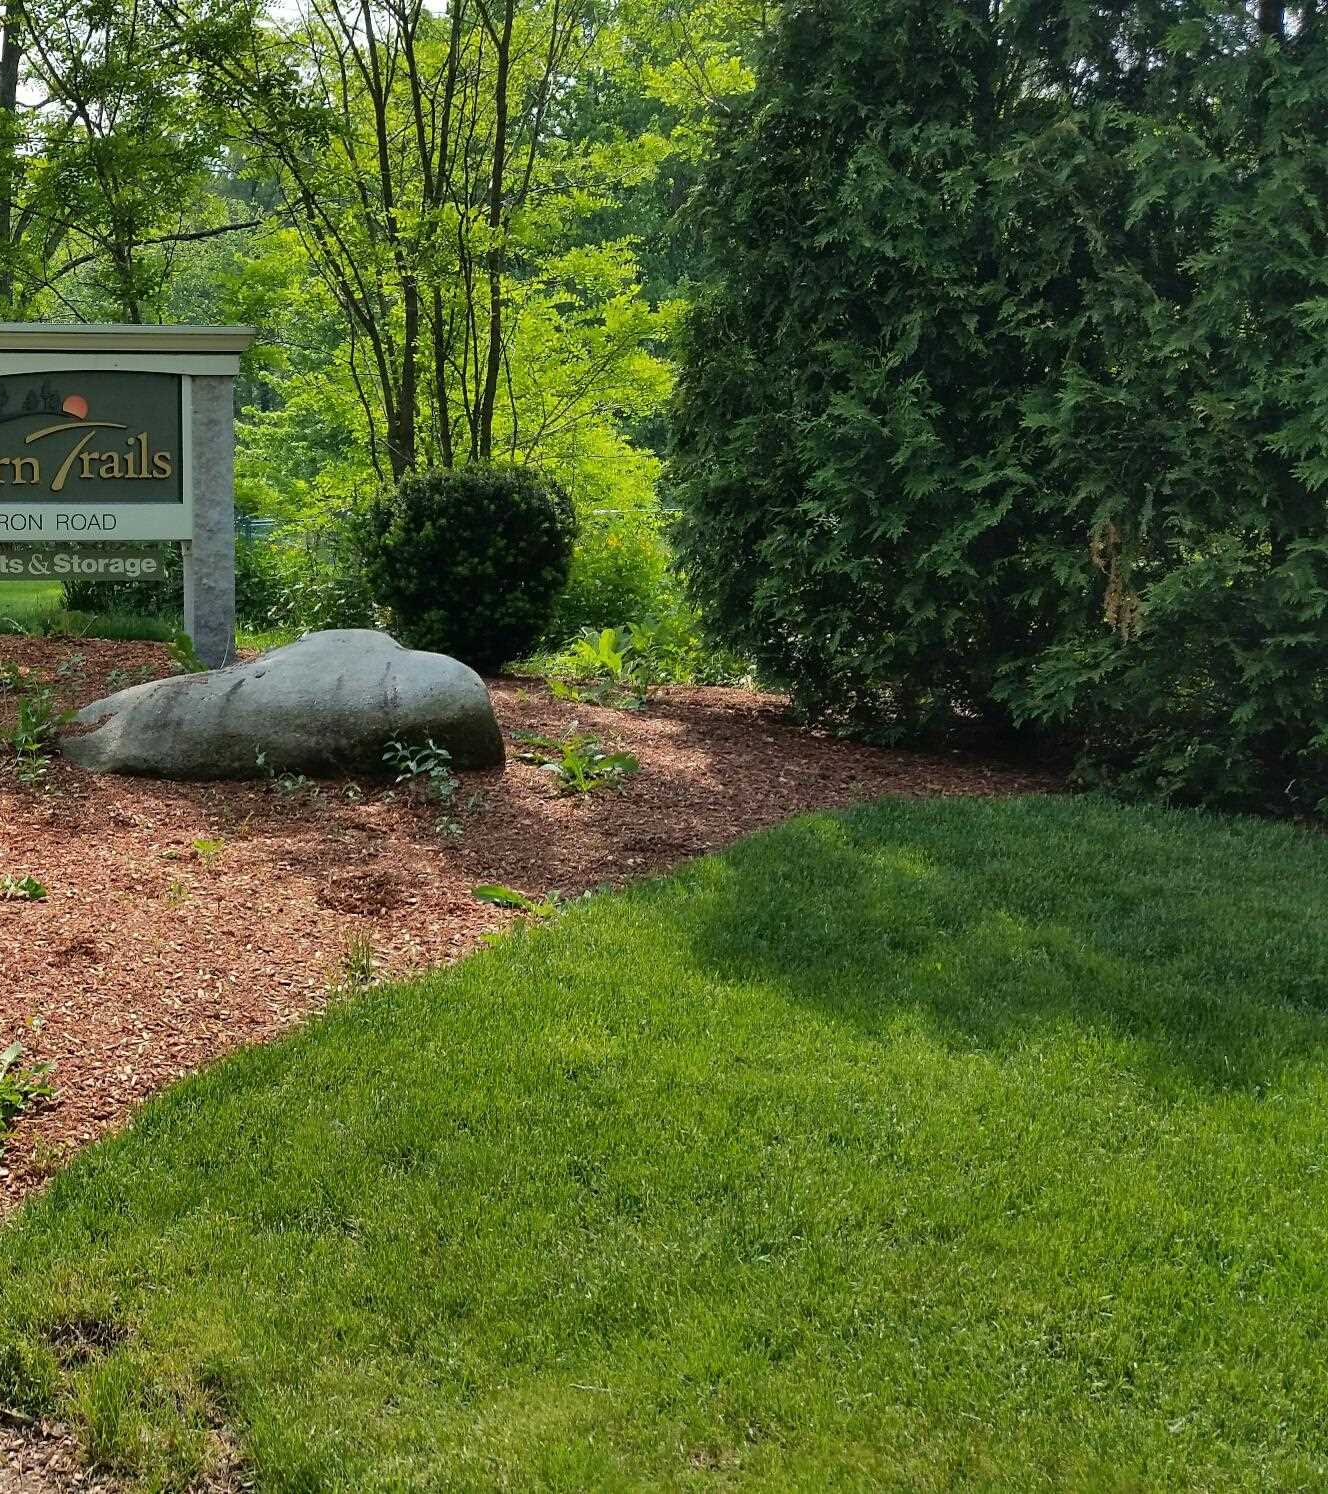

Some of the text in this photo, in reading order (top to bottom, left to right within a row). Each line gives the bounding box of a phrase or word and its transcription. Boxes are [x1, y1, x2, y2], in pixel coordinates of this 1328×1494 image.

[25, 422, 171, 491] Trails
[56, 514, 117, 531] ROAD
[28, 553, 51, 576] &
[53, 553, 157, 577] Storage
